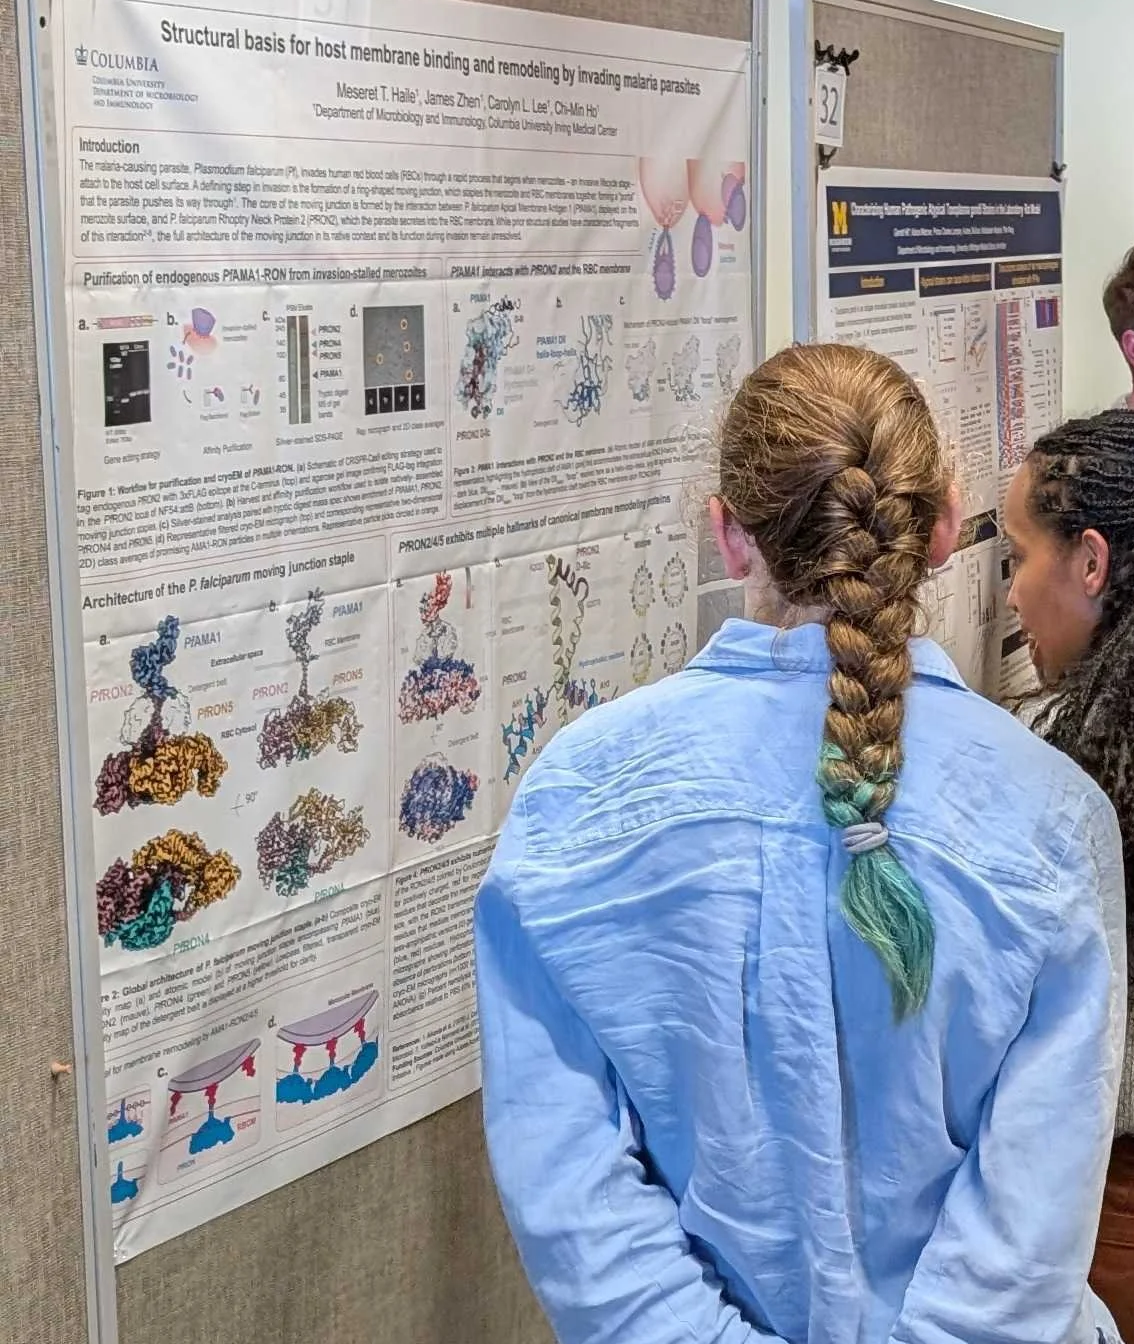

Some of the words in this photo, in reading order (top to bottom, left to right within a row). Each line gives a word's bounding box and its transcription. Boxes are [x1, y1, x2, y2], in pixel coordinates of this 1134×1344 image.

[90, 50, 159, 72] COLUMBIA
[160, 20, 240, 49] Structural
[244, 29, 285, 53] basis
[290, 34, 310, 56] for
[315, 37, 346, 59] host
[350, 44, 420, 67] membrane
[423, 49, 469, 76] binding
[473, 56, 494, 74] and
[498, 60, 559, 85] remodeling
[562, 64, 575, 87] by
[578, 66, 621, 91] invading
[623, 71, 658, 91] malaria
[660, 77, 701, 96] parasites
[336, 81, 378, 100] Meseret
[378, 85, 389, 101] T.
[424, 89, 454, 106] James
[488, 95, 520, 115] Carolyn
[522, 98, 530, 113] L.
[554, 101, 584, 117] Chi-Min
[820, 84, 839, 126] 32
[366, 108, 374, 120] of
[376, 109, 423, 126] Microbiology
[424, 113, 440, 124] and
[79, 136, 140, 154] Introduction
[79, 159, 93, 170] The
[241, 198, 257, 208] The
[83, 271, 140, 286] Purification
[142, 271, 152, 284] of
[155, 270, 220, 286] endogenous
[222, 268, 286, 282] PfAMA1-RON
[288, 268, 310, 280] from
[312, 267, 381, 280] invasion-stalled
[382, 266, 426, 279] merozoites
[76, 488, 105, 500] Figure
[158, 476, 201, 490] purification
[398, 535, 444, 553] PfRON2/4/5
[445, 530, 474, 545] exhibits
[475, 525, 504, 539] multiple
[506, 518, 538, 534] hallmarks
[547, 511, 579, 526] canonical
[82, 588, 153, 609] Architecture
[155, 583, 165, 597] of
[167, 581, 185, 595] the
[188, 578, 197, 591] P.
[199, 572, 250, 589] falciparum
[252, 565, 285, 580] moving
[287, 557, 326, 577] junction
[328, 551, 354, 566] staple
[332, 602, 363, 617] PfAMA1
[184, 632, 221, 649] PfAMA1
[90, 684, 133, 702] PfRON2
[252, 682, 288, 700] PfRON2
[197, 700, 234, 720] PfRON5
[173, 934, 210, 956] PfRON4
[122, 980, 147, 996] Global
